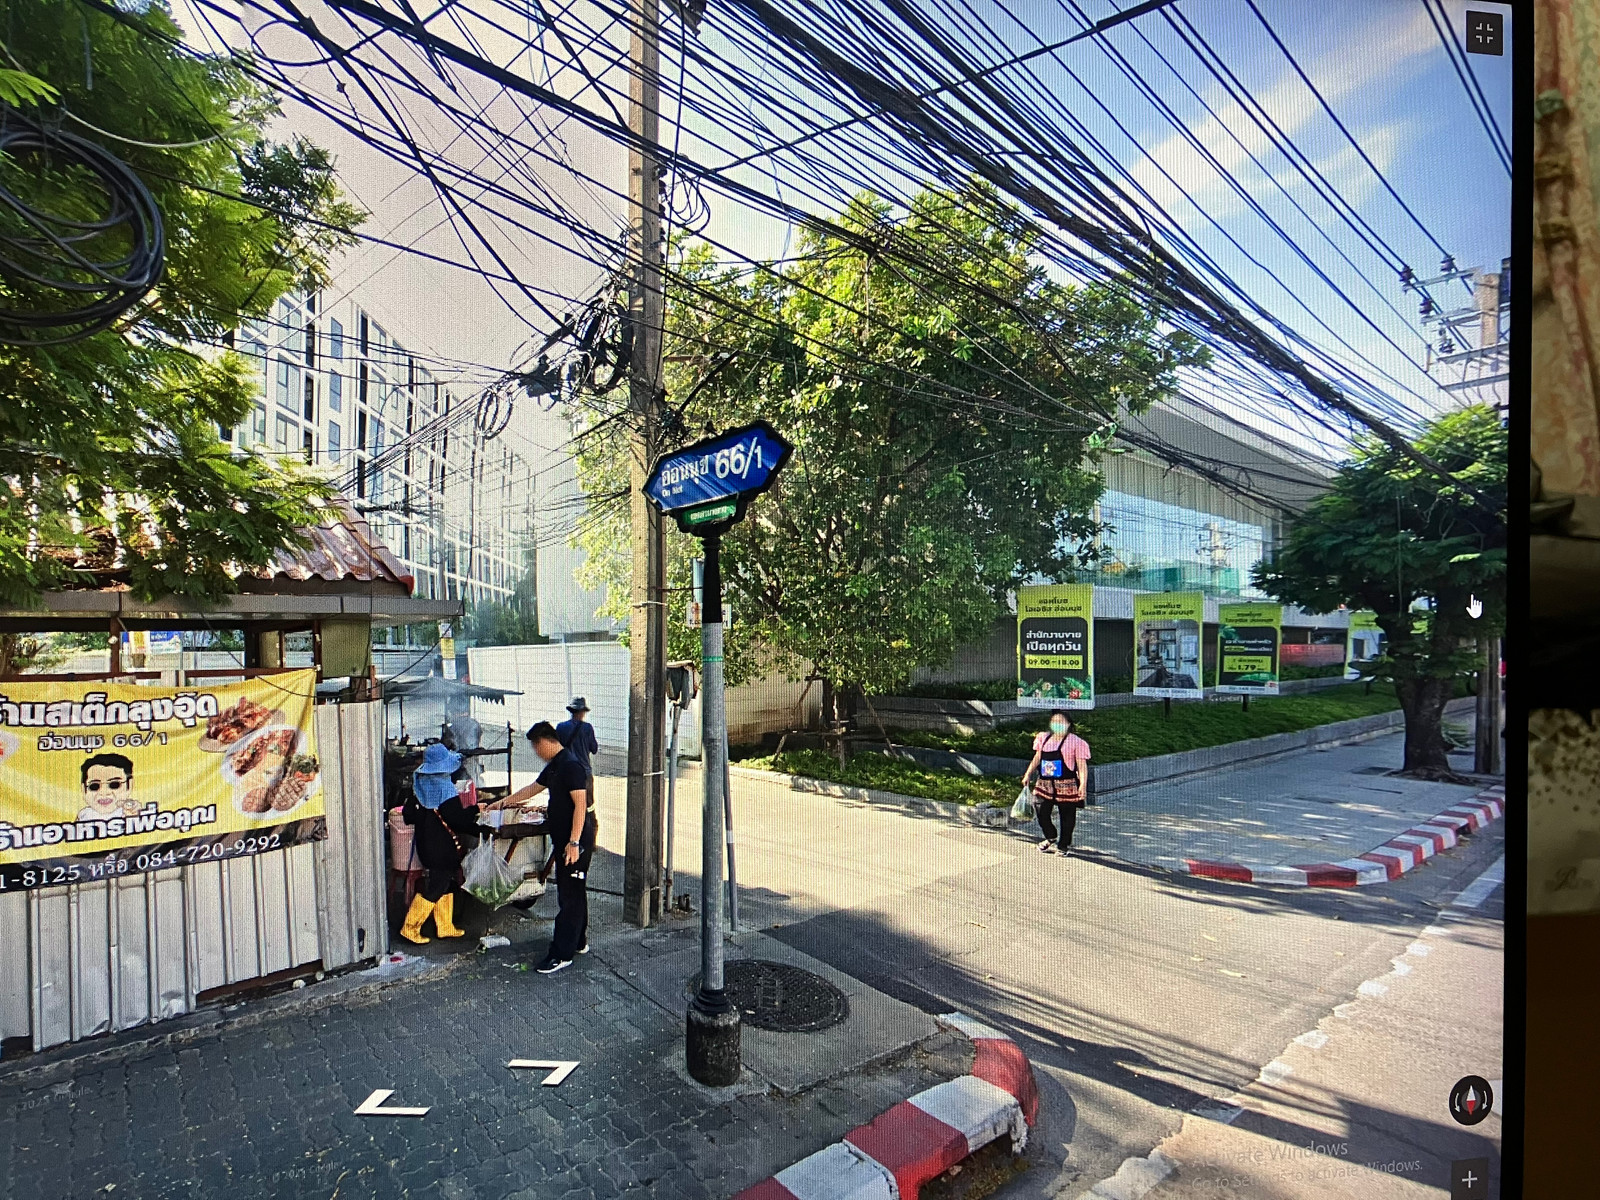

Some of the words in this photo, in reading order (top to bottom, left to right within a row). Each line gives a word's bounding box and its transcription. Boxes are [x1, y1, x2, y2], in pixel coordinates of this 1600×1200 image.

[661, 455, 709, 487] อ่อนนุช
[715, 436, 763, 480] 66/1
[1026, 630, 1082, 639] สำนักงานขาย
[1026, 641, 1082, 654] เปิดทุกวัน
[38, 731, 104, 753] อ่อนนุช
[113, 731, 167, 747] 66/1
[88, 853, 129, 877] หรือ
[136, 833, 281, 870] 084-720-9292
[1270, 1140, 1349, 1161] Windows
[1192, 1177, 1211, 1190] Go
[1215, 1175, 1230, 1189] to
